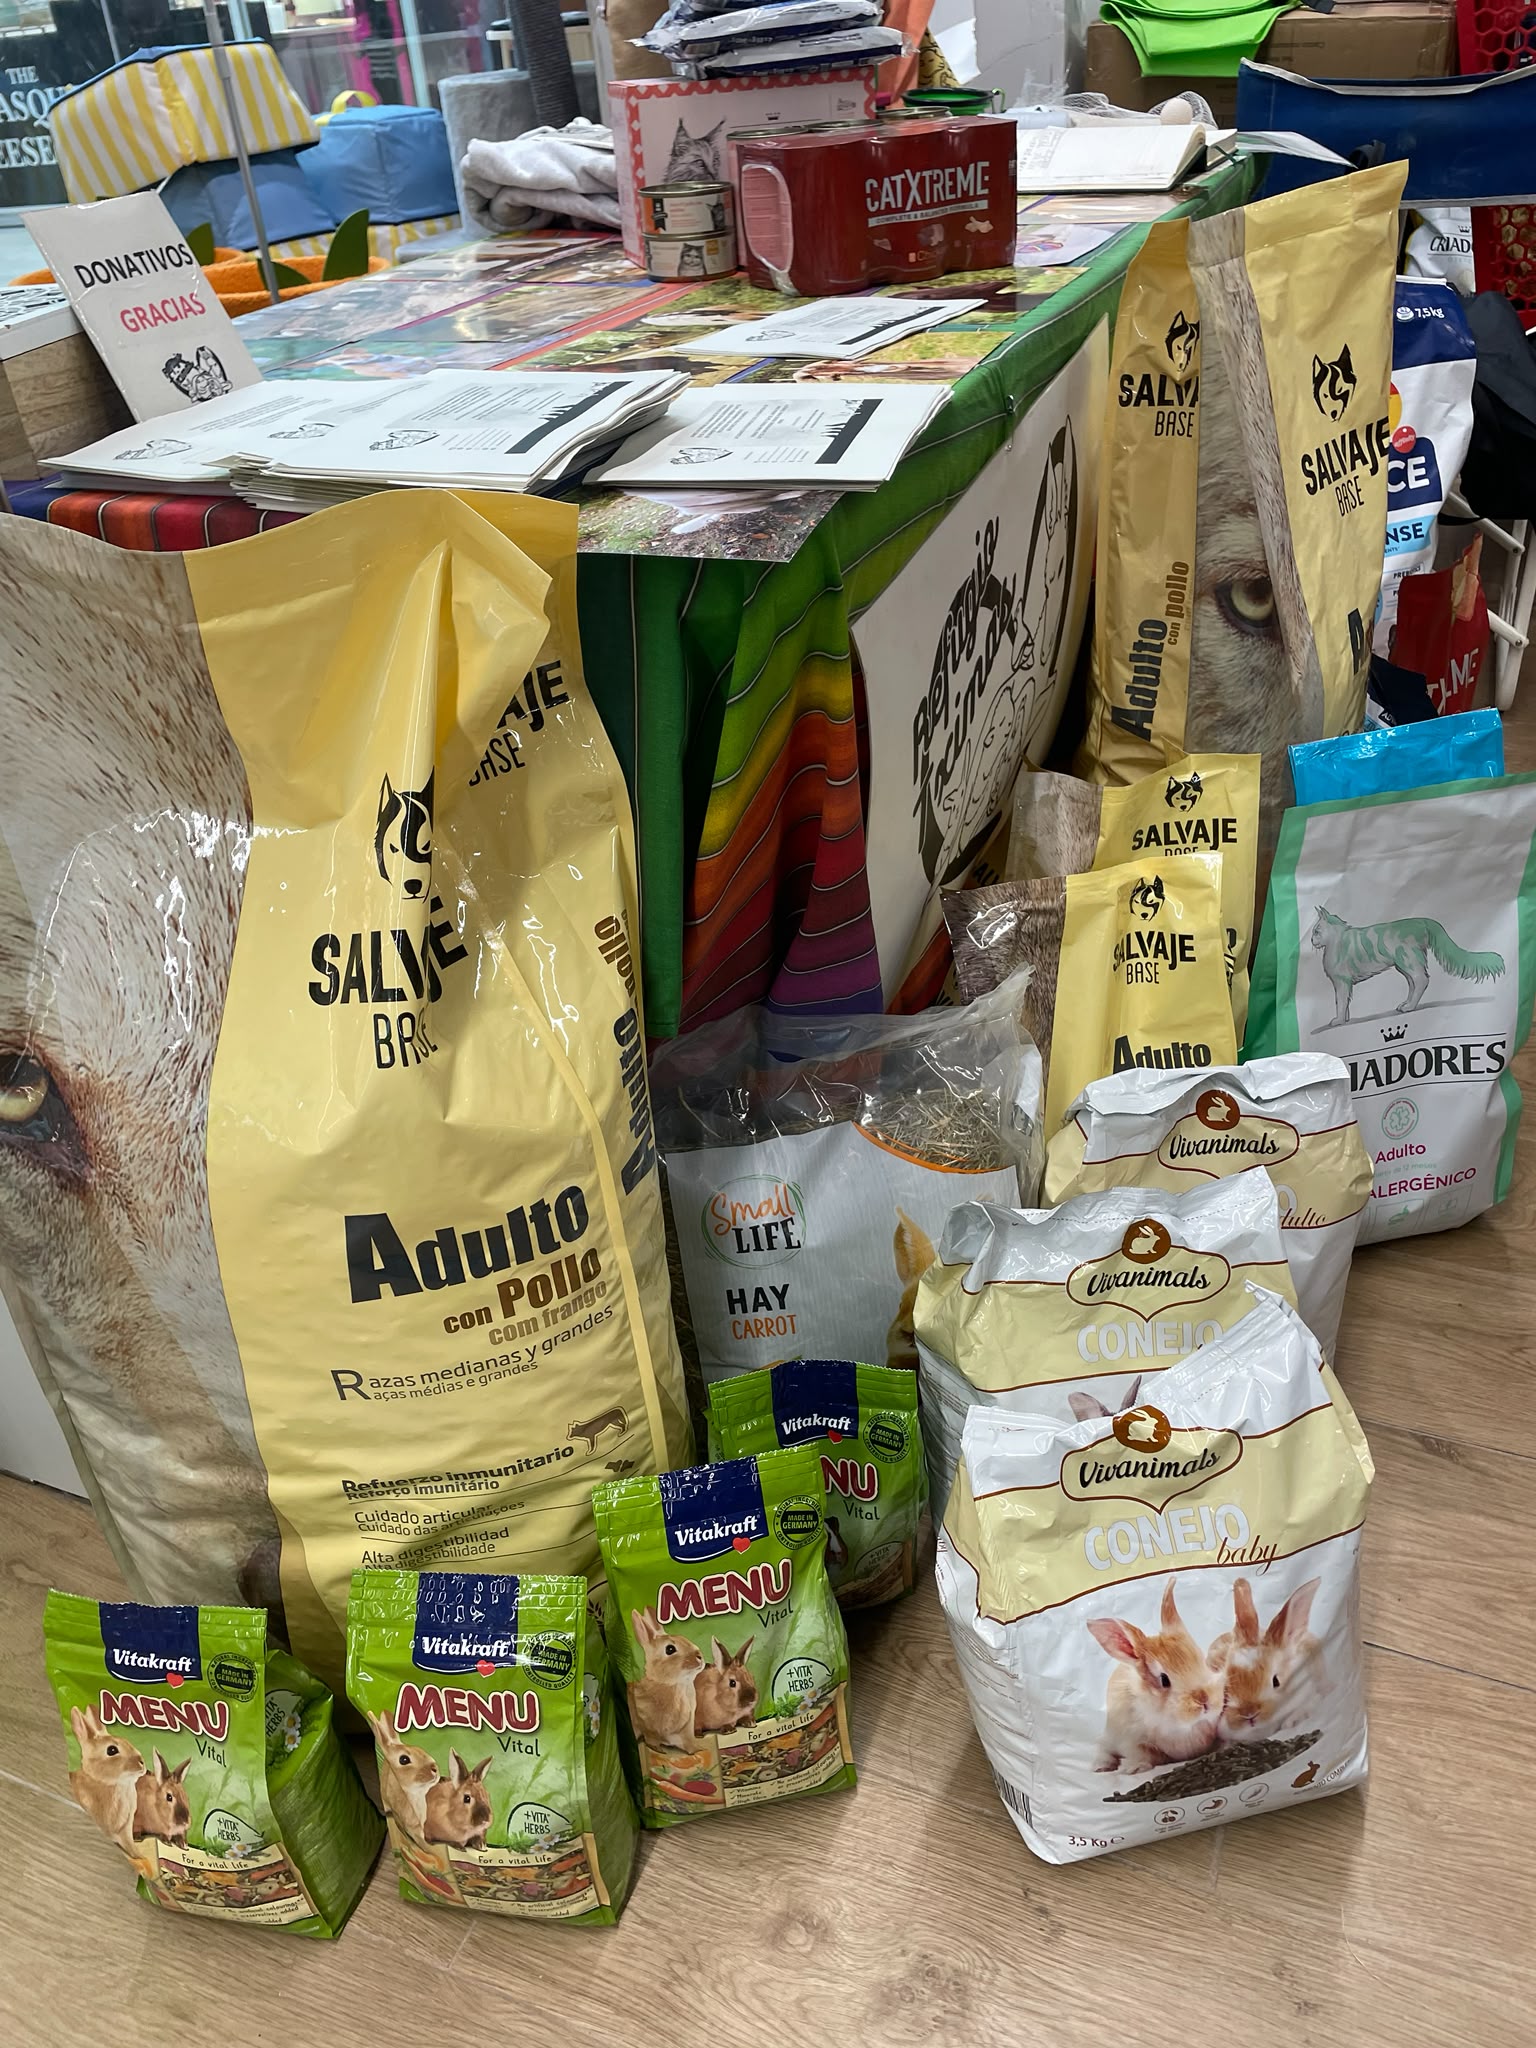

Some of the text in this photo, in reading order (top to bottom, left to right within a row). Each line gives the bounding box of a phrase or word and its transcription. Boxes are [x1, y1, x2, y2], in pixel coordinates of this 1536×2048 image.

[5, 66, 39, 84] THE
[865, 161, 990, 212] CATXTREME
[74, 243, 194, 288] DONATIVOS
[120, 292, 206, 333] GRACIAS
[1154, 410, 1193, 438] BASE
[1301, 415, 1390, 496] SALVAJE
[1336, 475, 1365, 518] BASE
[1165, 561, 1190, 619] pollo
[1167, 622, 1181, 646] con
[913, 516, 999, 786] Refugio
[1110, 619, 1168, 742] Adulto
[1132, 818, 1238, 851] SALVAJE
[1113, 931, 1197, 971] SALVAJE
[1126, 961, 1160, 985] BASE
[373, 1009, 438, 1069] BASE
[1113, 1034, 1212, 1074] Adulto
[1169, 1132, 1280, 1160] Vivanimals
[1375, 1143, 1426, 1164] Adulto
[711, 1184, 796, 1236] Small
[344, 1185, 590, 1304] Adulto
[732, 1217, 802, 1254] LIFE
[443, 1247, 602, 1335] con Pollo
[1086, 1265, 1211, 1298] Vivanimals
[489, 1280, 607, 1347] com frango
[726, 1283, 790, 1315] HAY
[732, 1314, 797, 1341] CARROT
[1077, 1319, 1224, 1363] CONEJO
[420, 1348, 522, 1385] medianas
[524, 1344, 537, 1363] y
[541, 1305, 614, 1356] grandes
[410, 1378, 463, 1399] médias
[466, 1377, 476, 1388] e
[479, 1360, 539, 1387] grandes
[782, 1414, 851, 1435] Vitakraft
[876, 1429, 892, 1439] MADE
[870, 1433, 903, 1448] GERMANY
[341, 1445, 575, 1494] Refuerzo inmunitario
[1079, 1447, 1221, 1488] Vivanimals
[414, 1477, 500, 1495] imunitário
[354, 1509, 420, 1525] Cuidado
[782, 1520, 818, 1529] GERMANY
[842, 1498, 881, 1521] Vital
[358, 1522, 411, 1536] Cuidado
[413, 1523, 439, 1536] das
[674, 1514, 760, 1547] Vitakraft
[1083, 1502, 1251, 1572] CONEJO
[361, 1527, 510, 1564] Alta digestibilidad
[394, 1542, 496, 1571] digestibilidade
[1216, 1534, 1278, 1577] baby
[656, 1558, 793, 1625] MENU
[757, 1599, 794, 1628] Vital
[112, 1648, 193, 1673] Vitakraft
[423, 1635, 510, 1658] Vitakraft
[540, 1650, 567, 1662] MADE IN
[221, 1668, 249, 1679] MADE IN
[533, 1656, 570, 1671] GERMANY
[216, 1673, 253, 1687] GERMANY
[788, 1677, 814, 1692] HERBS
[99, 1688, 230, 1742] MENU
[265, 1707, 286, 1737] HERBS
[393, 1681, 542, 1733] MENU
[748, 1728, 762, 1741] For
[776, 1719, 796, 1733] vital
[799, 1713, 815, 1726] life
[195, 1737, 227, 1768] Vital
[497, 1736, 541, 1757] Vital
[217, 1828, 241, 1842] HERBS
[524, 1822, 550, 1835] HERBS
[1068, 1835, 1107, 1849] 3,5 Kg
[182, 1853, 195, 1865] For
[207, 1861, 229, 1870] vital
[232, 1861, 249, 1869] life
[478, 1855, 496, 1865] For
[509, 1855, 531, 1865] vital
[535, 1854, 552, 1864] life
